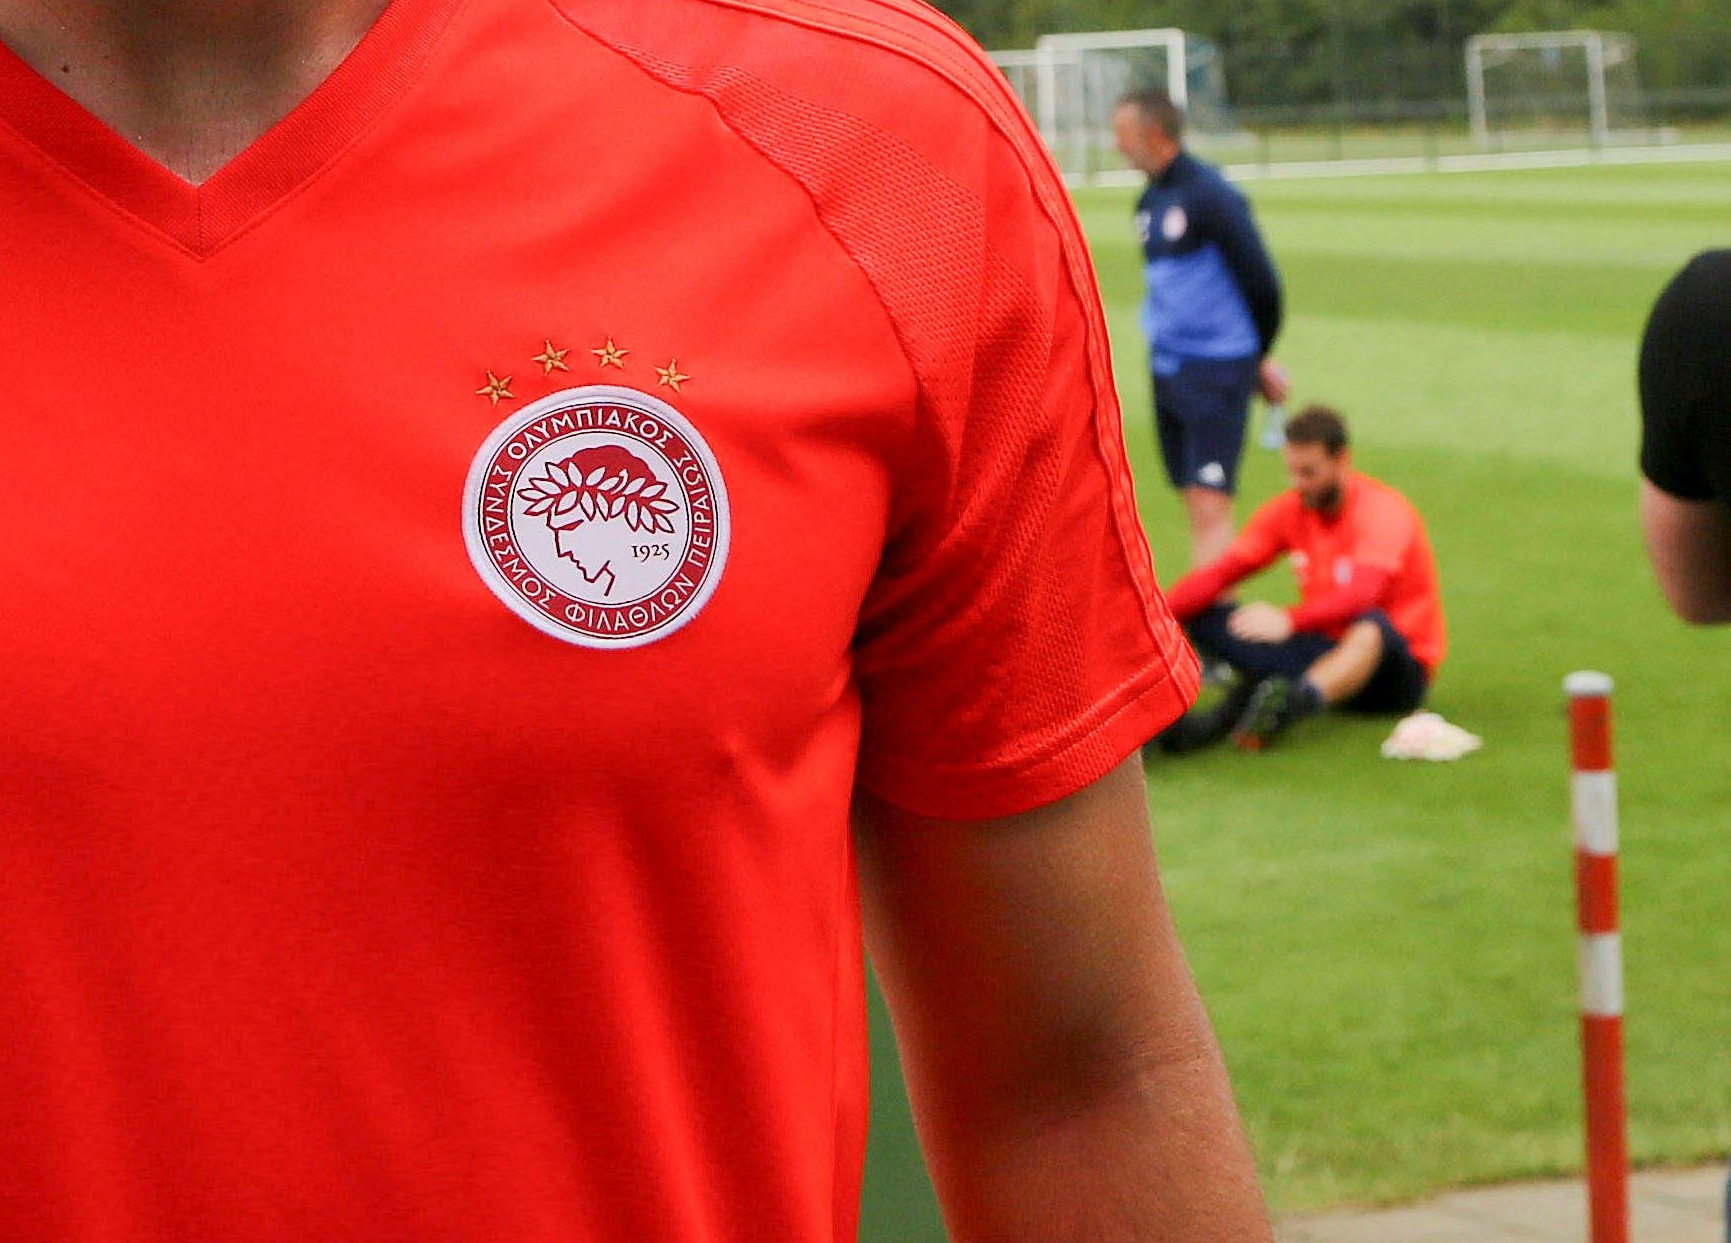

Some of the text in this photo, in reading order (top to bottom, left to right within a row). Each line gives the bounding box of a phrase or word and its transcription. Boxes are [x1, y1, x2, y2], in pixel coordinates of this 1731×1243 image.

[508, 409, 673, 460] ΟΛΥΜΠΙΑΚΟΣ
[485, 451, 711, 631] ΣΥΝΔΕΣΜΟΣ ΦΙΛΑΘΛΩΝ ΠΕΙΡΑΙΩΣ
[632, 544, 670, 562] 1925
